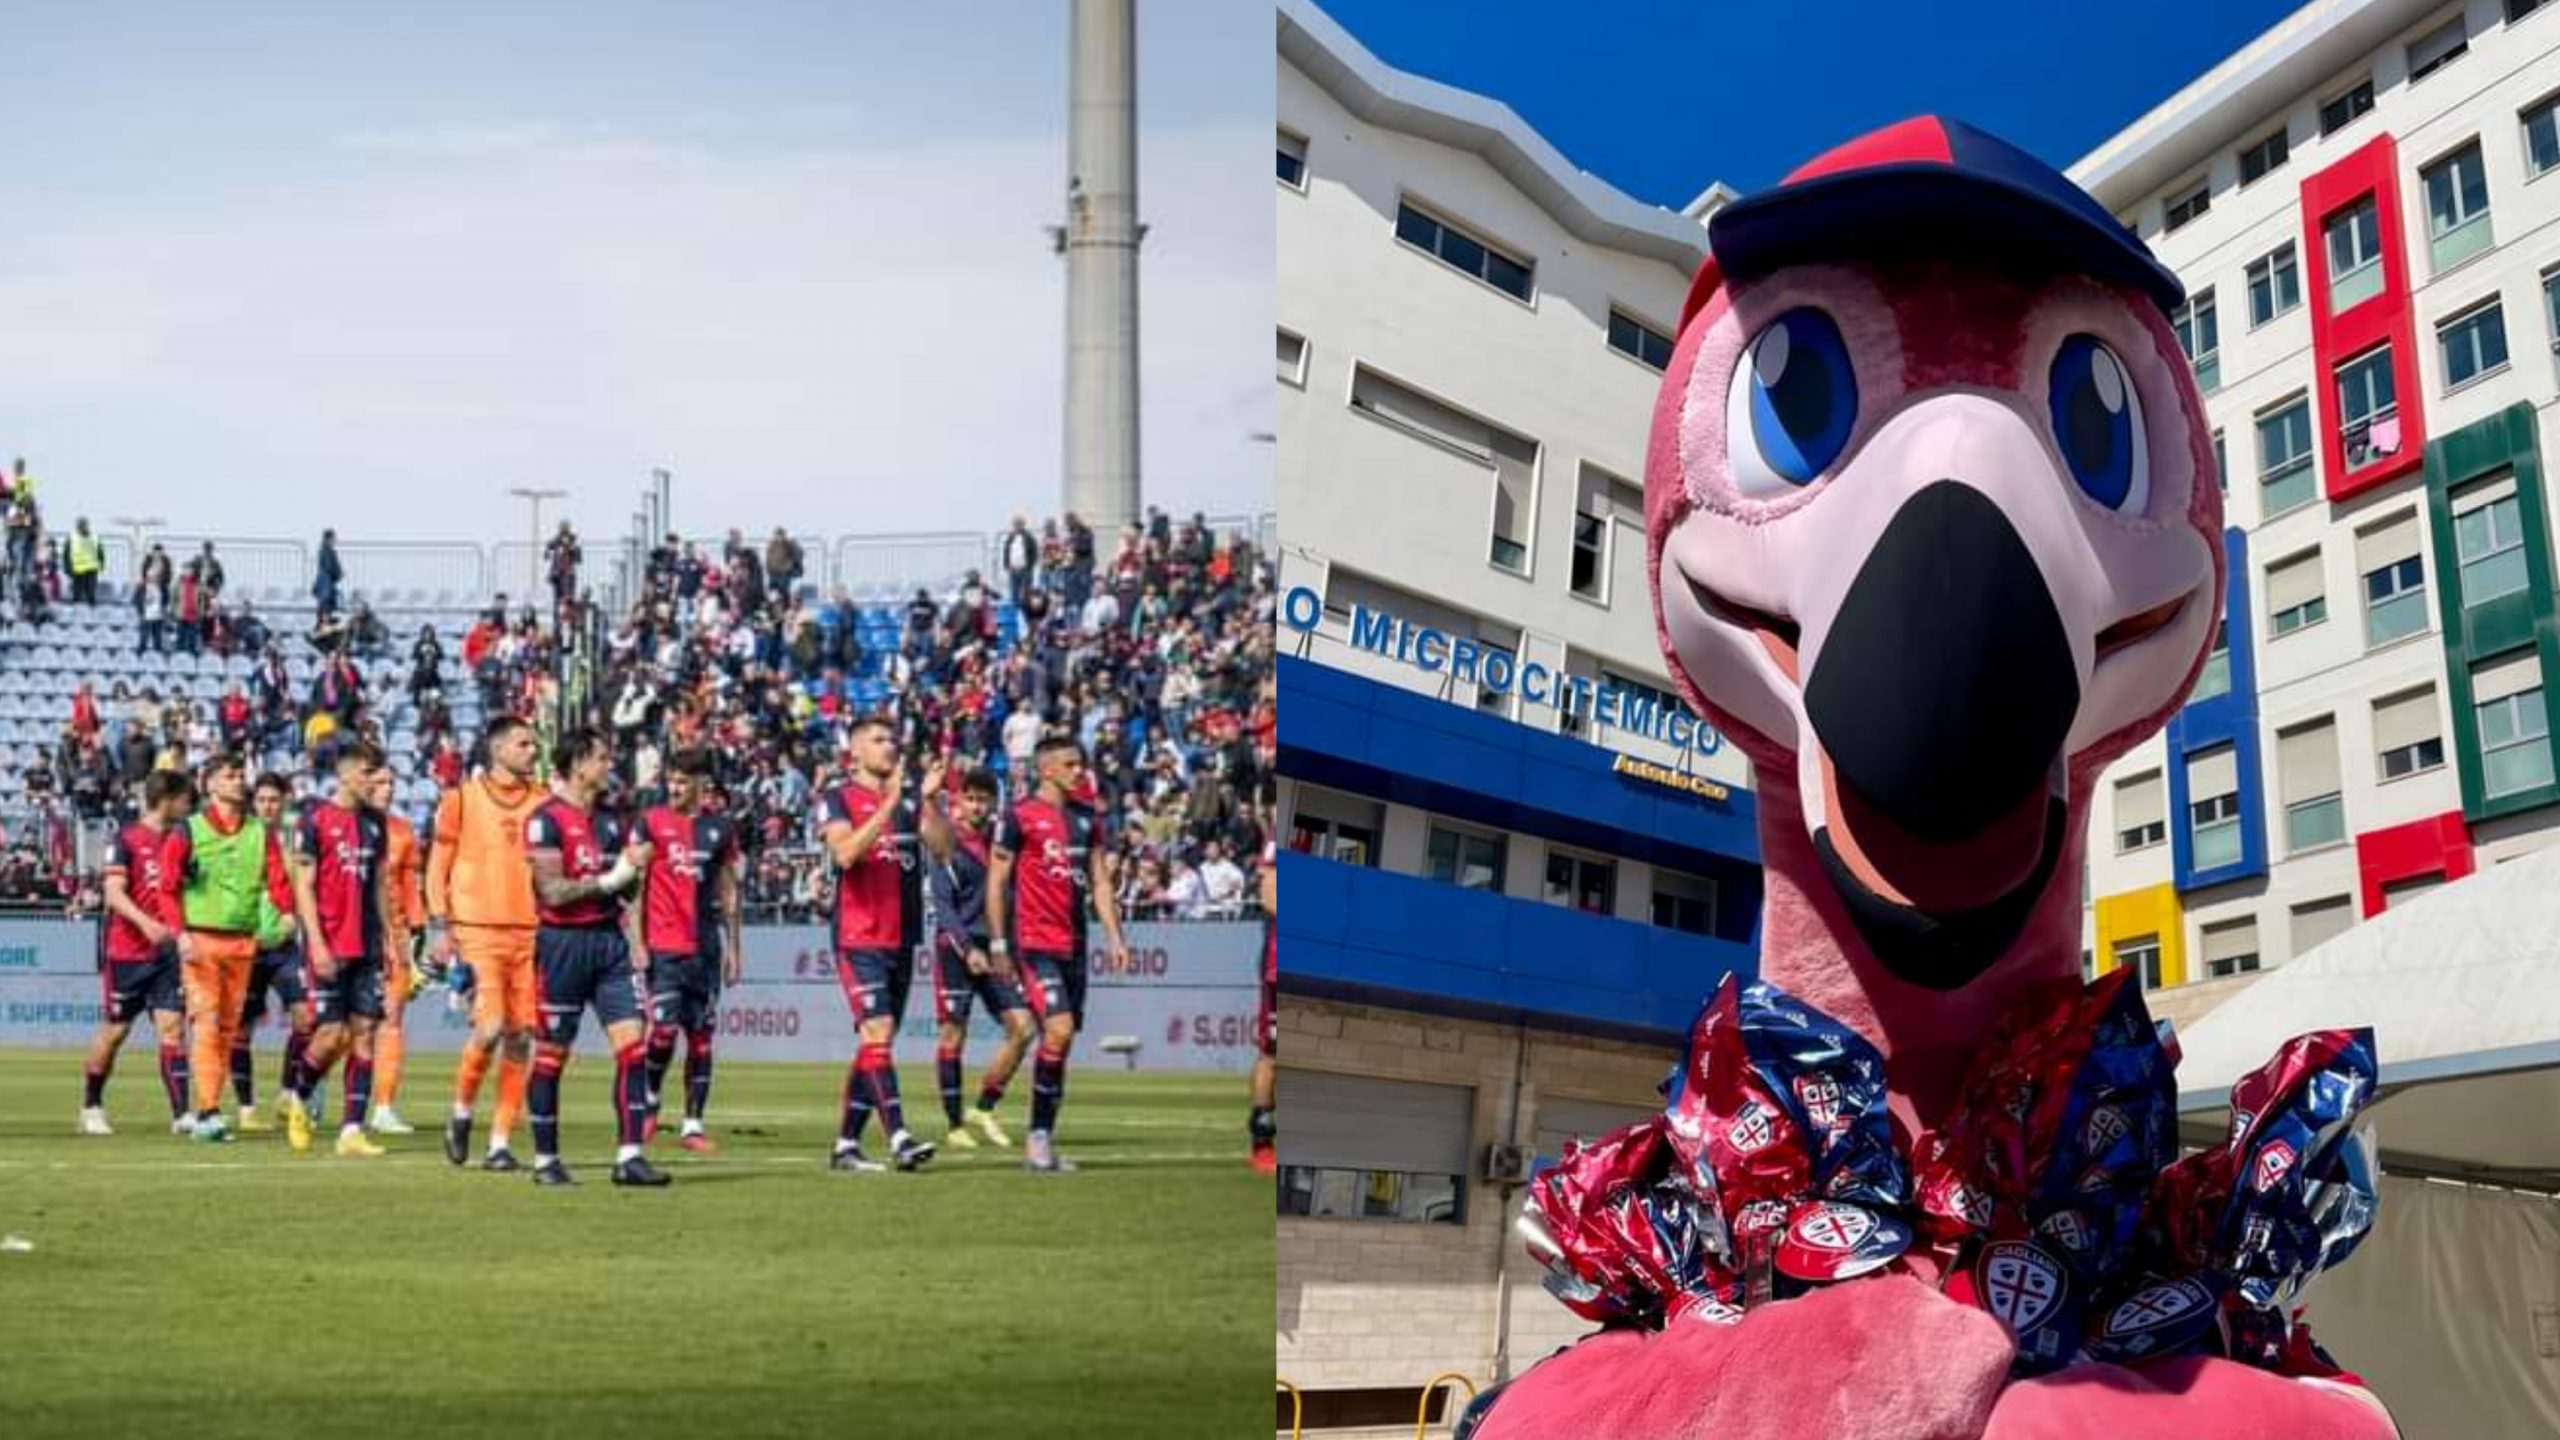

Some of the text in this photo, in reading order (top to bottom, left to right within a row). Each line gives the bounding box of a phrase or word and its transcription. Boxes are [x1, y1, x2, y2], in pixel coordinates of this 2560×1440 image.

[1284, 586, 1722, 757] O MICROCITEMICO
[1612, 752, 1689, 790] Antonio
